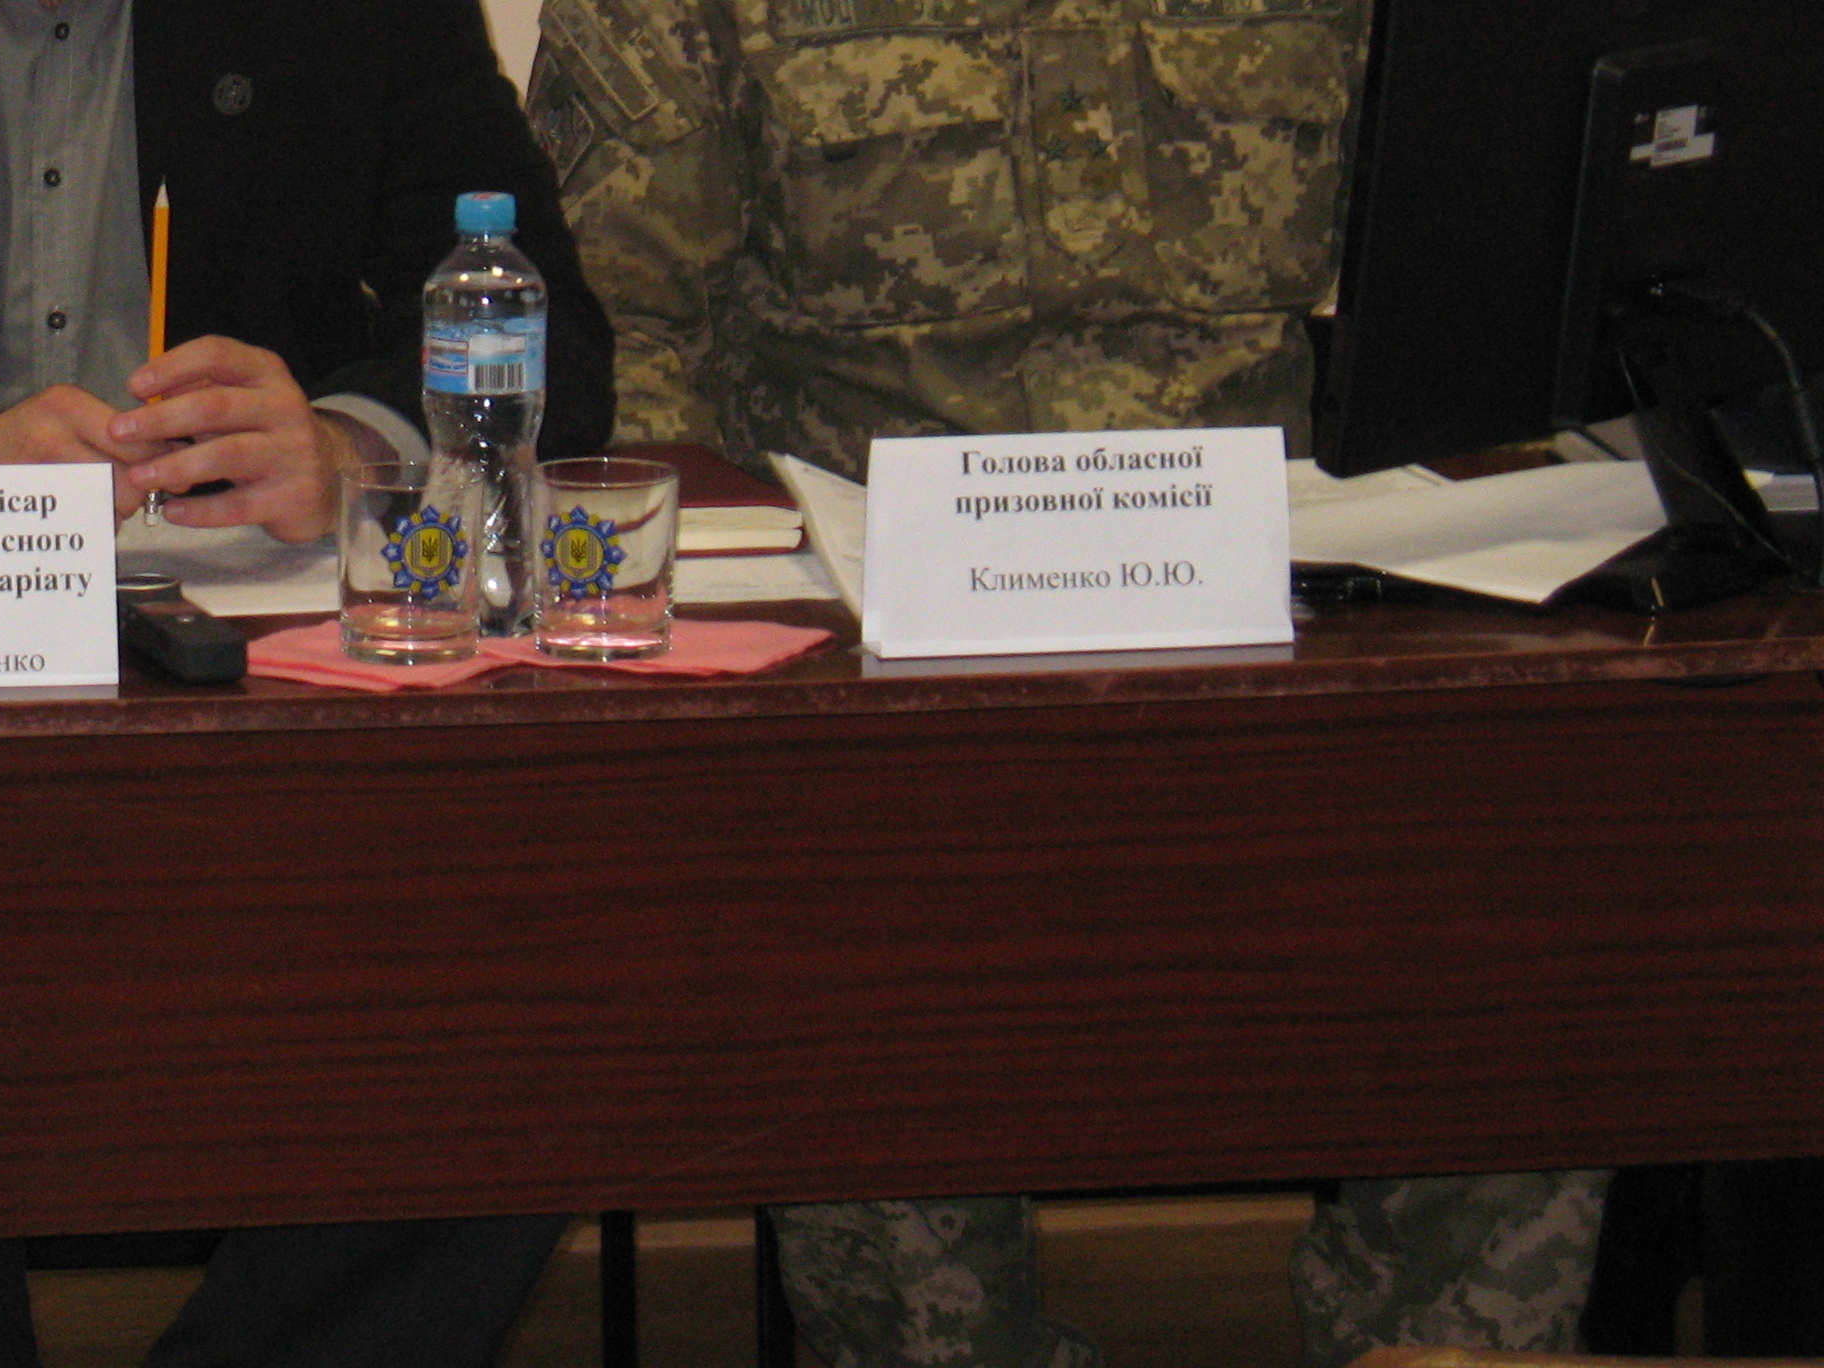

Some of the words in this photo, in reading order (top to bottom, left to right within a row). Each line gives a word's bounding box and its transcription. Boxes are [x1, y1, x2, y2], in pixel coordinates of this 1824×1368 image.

[961, 450, 1067, 476] Голова
[1075, 446, 1204, 472] обласної
[955, 487, 1105, 521] призовної
[1112, 483, 1214, 510] комісії
[969, 566, 1112, 592] Клименко
[1119, 562, 1205, 588] Ю.Ю.
